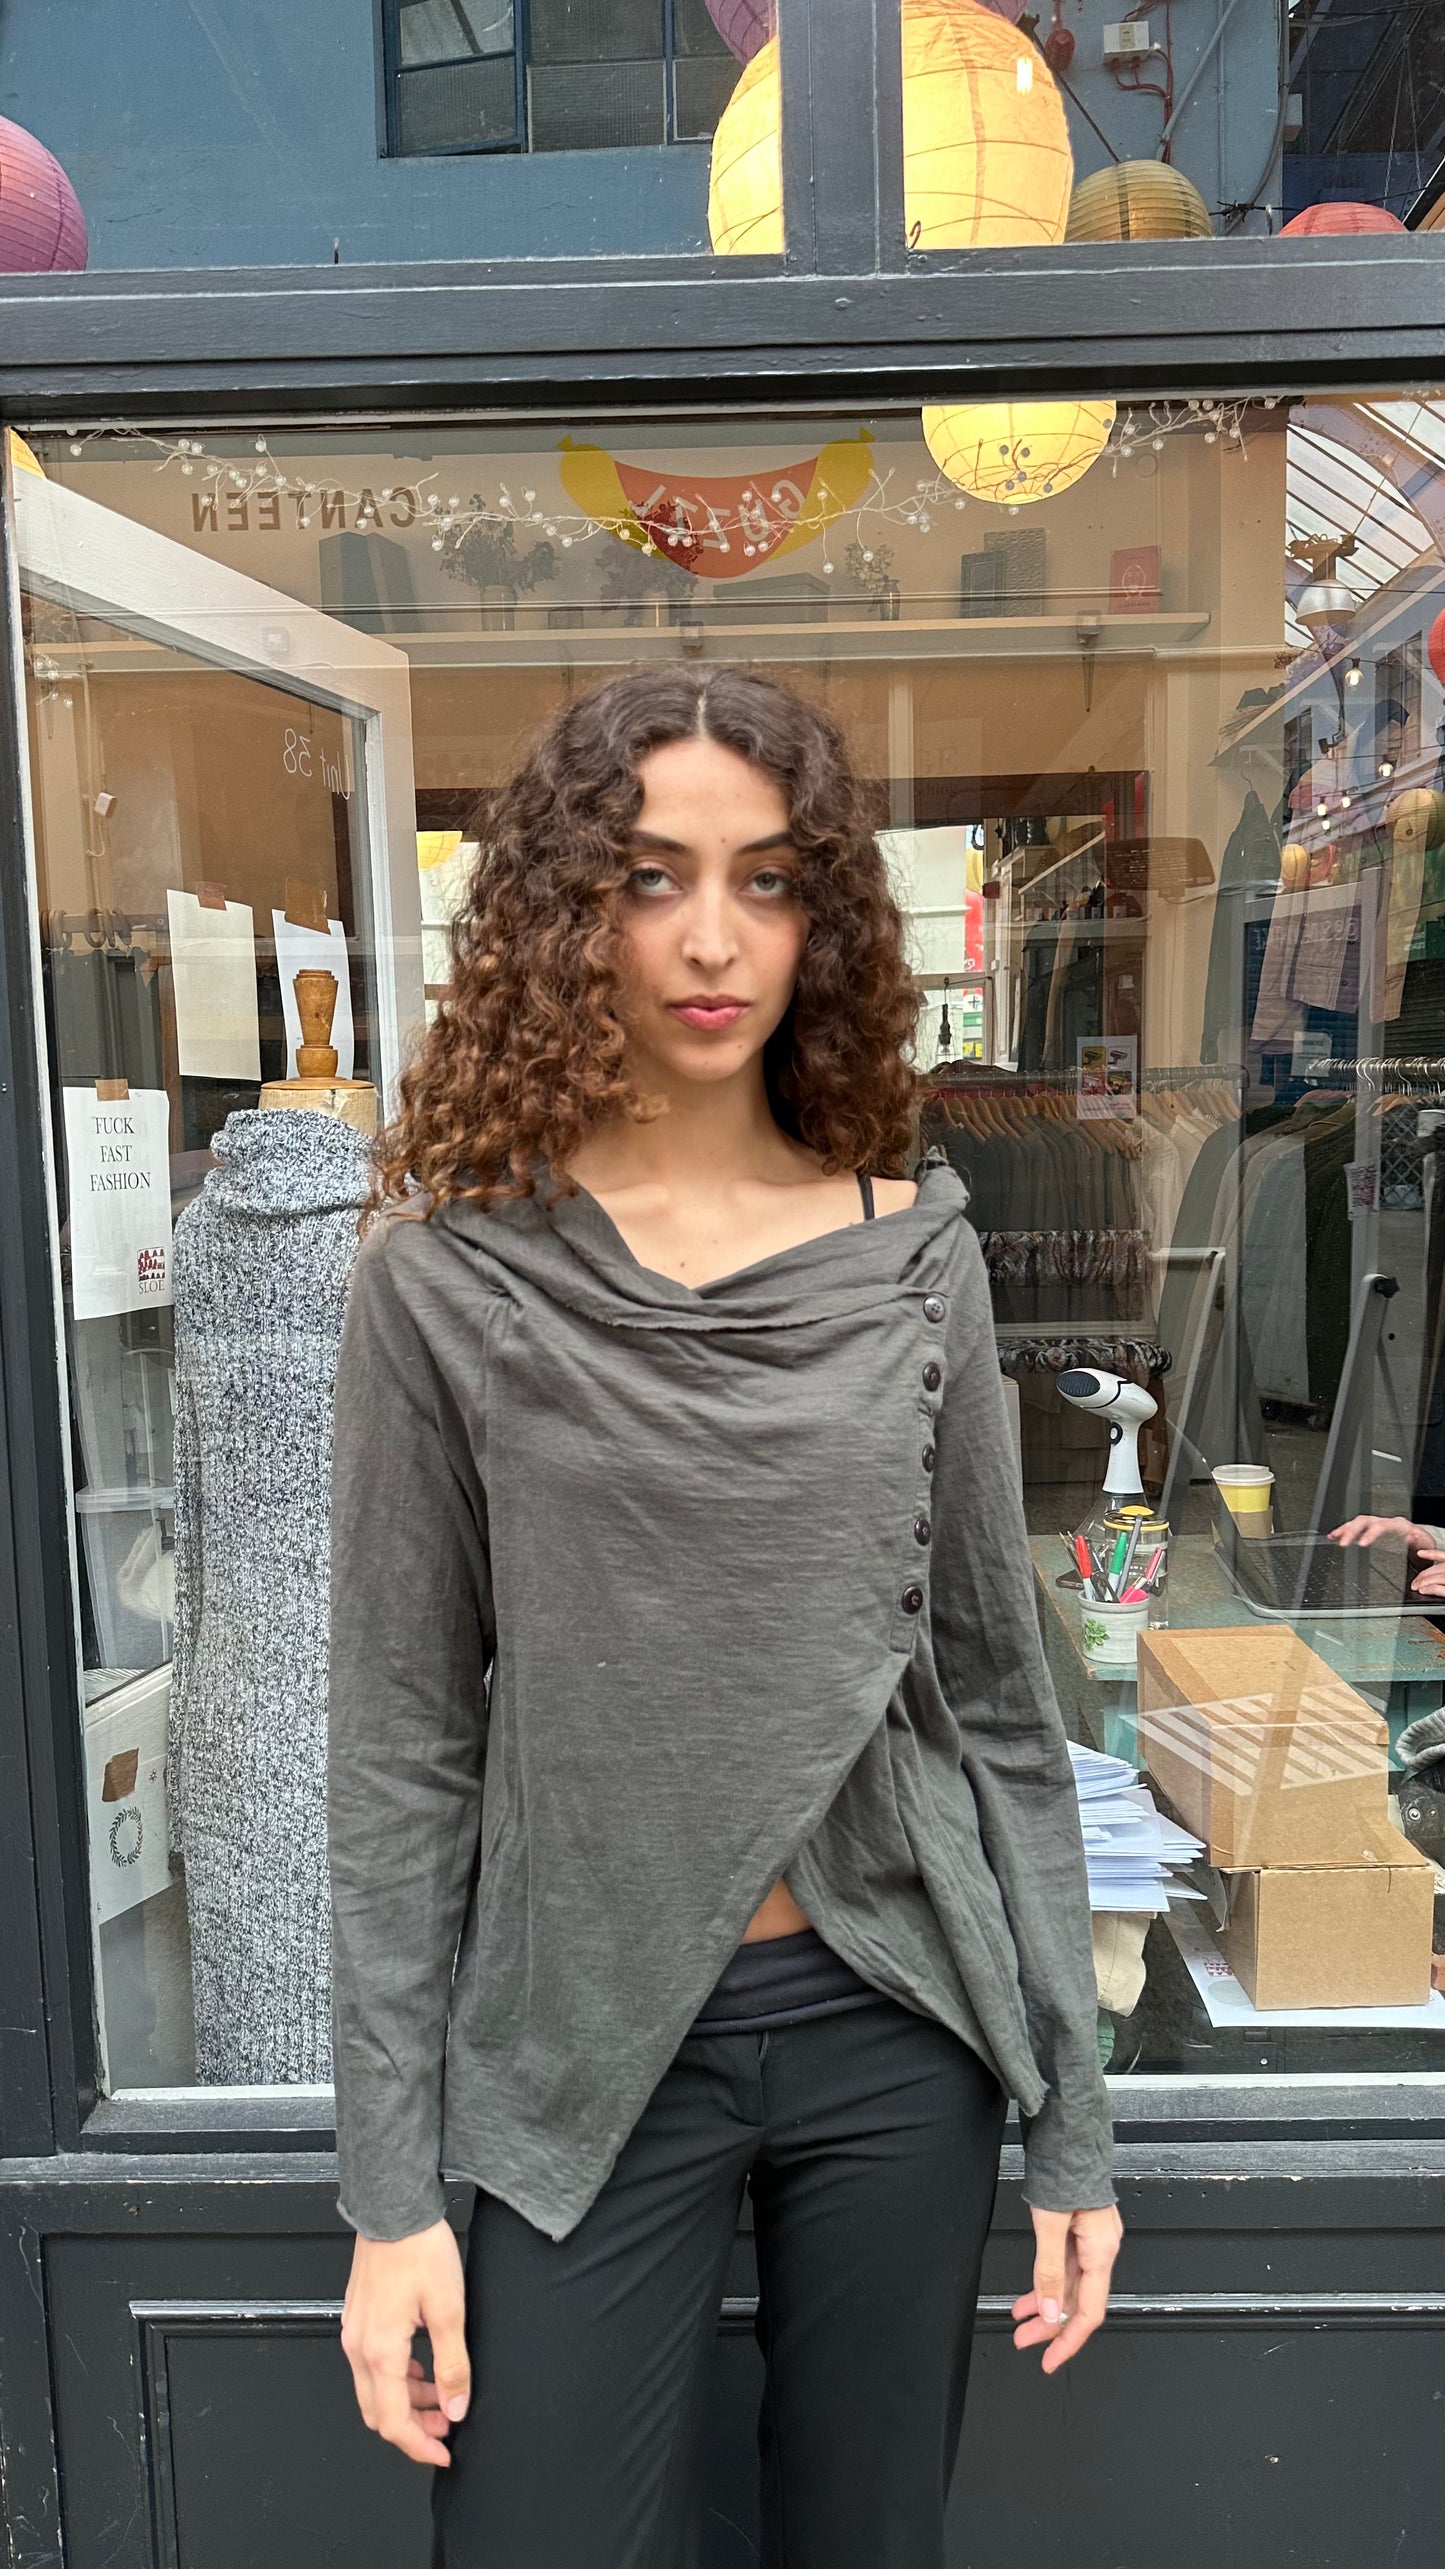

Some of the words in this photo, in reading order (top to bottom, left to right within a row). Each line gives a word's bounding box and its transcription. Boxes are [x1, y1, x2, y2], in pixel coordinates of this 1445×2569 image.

[95, 1117, 134, 1134] FUCK
[100, 1145, 132, 1162] FAST
[90, 1172, 151, 1192] FASHION
[138, 1280, 165, 1294] SLOE
